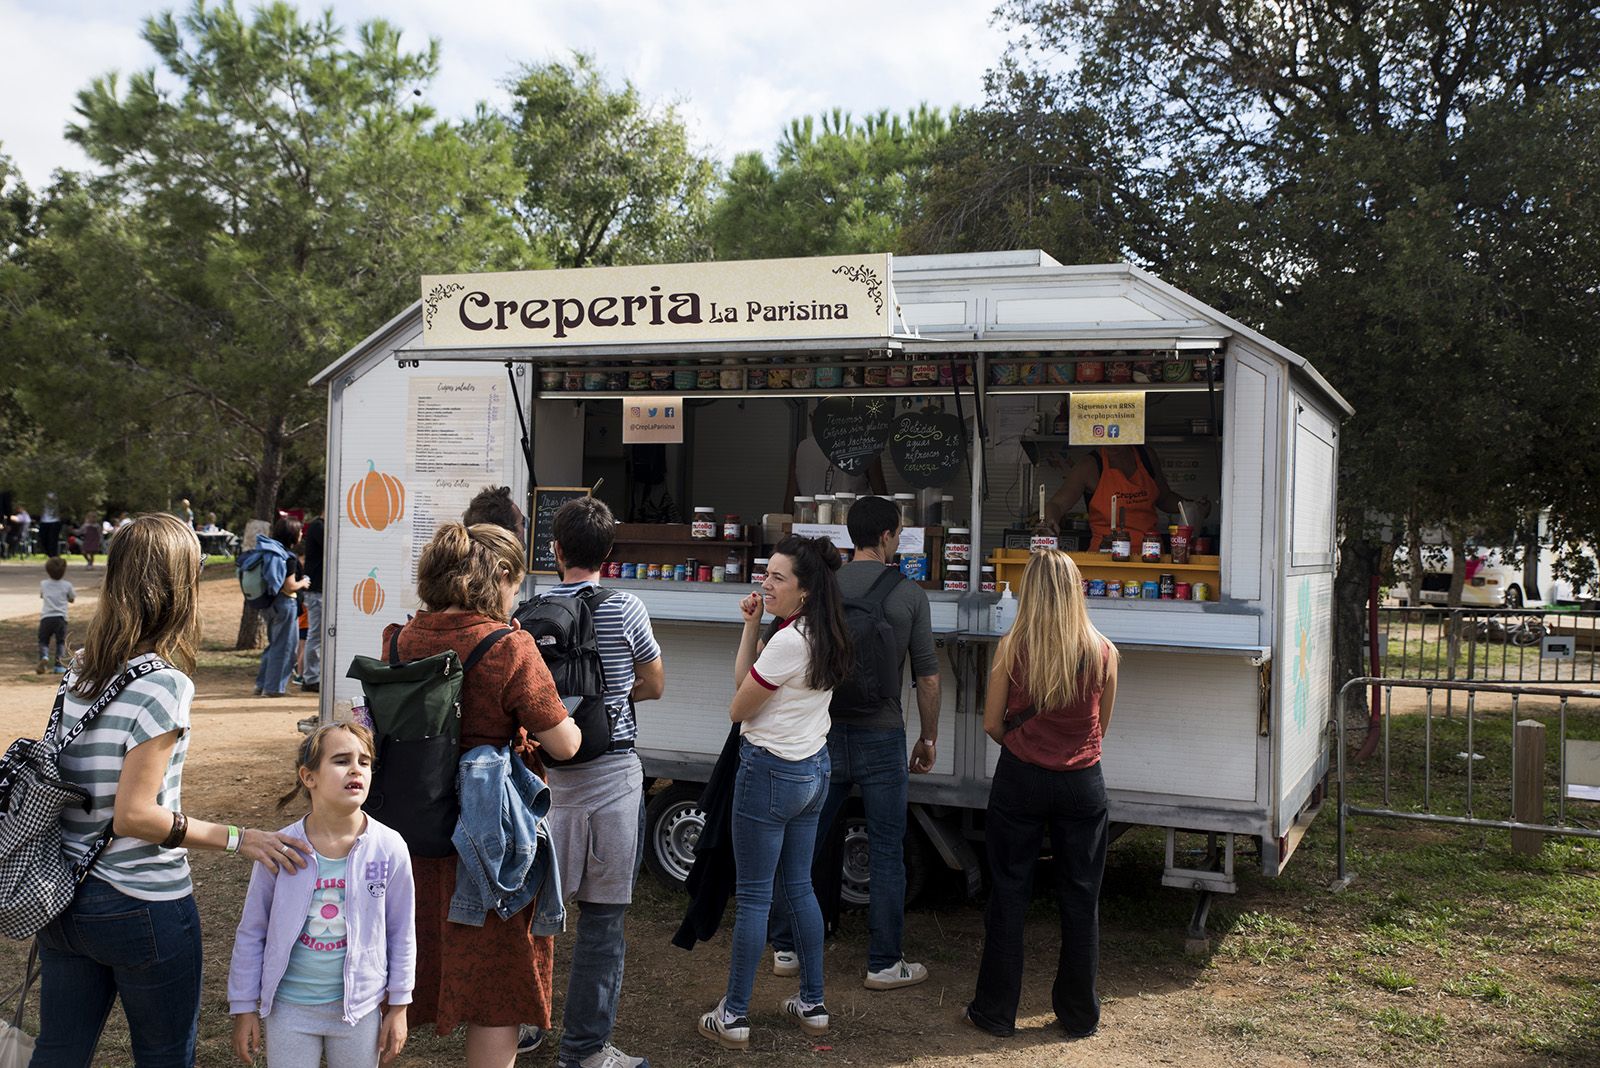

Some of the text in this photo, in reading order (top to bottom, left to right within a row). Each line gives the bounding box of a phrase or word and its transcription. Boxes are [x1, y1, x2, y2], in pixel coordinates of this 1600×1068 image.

[459, 285, 849, 338] Creperia La Parisina
[899, 417, 937, 433] Bebidas
[1170, 535, 1187, 544] ocilla
[944, 582, 968, 590] nutella
[127, 659, 173, 679] 198
[315, 878, 346, 889] Jus
